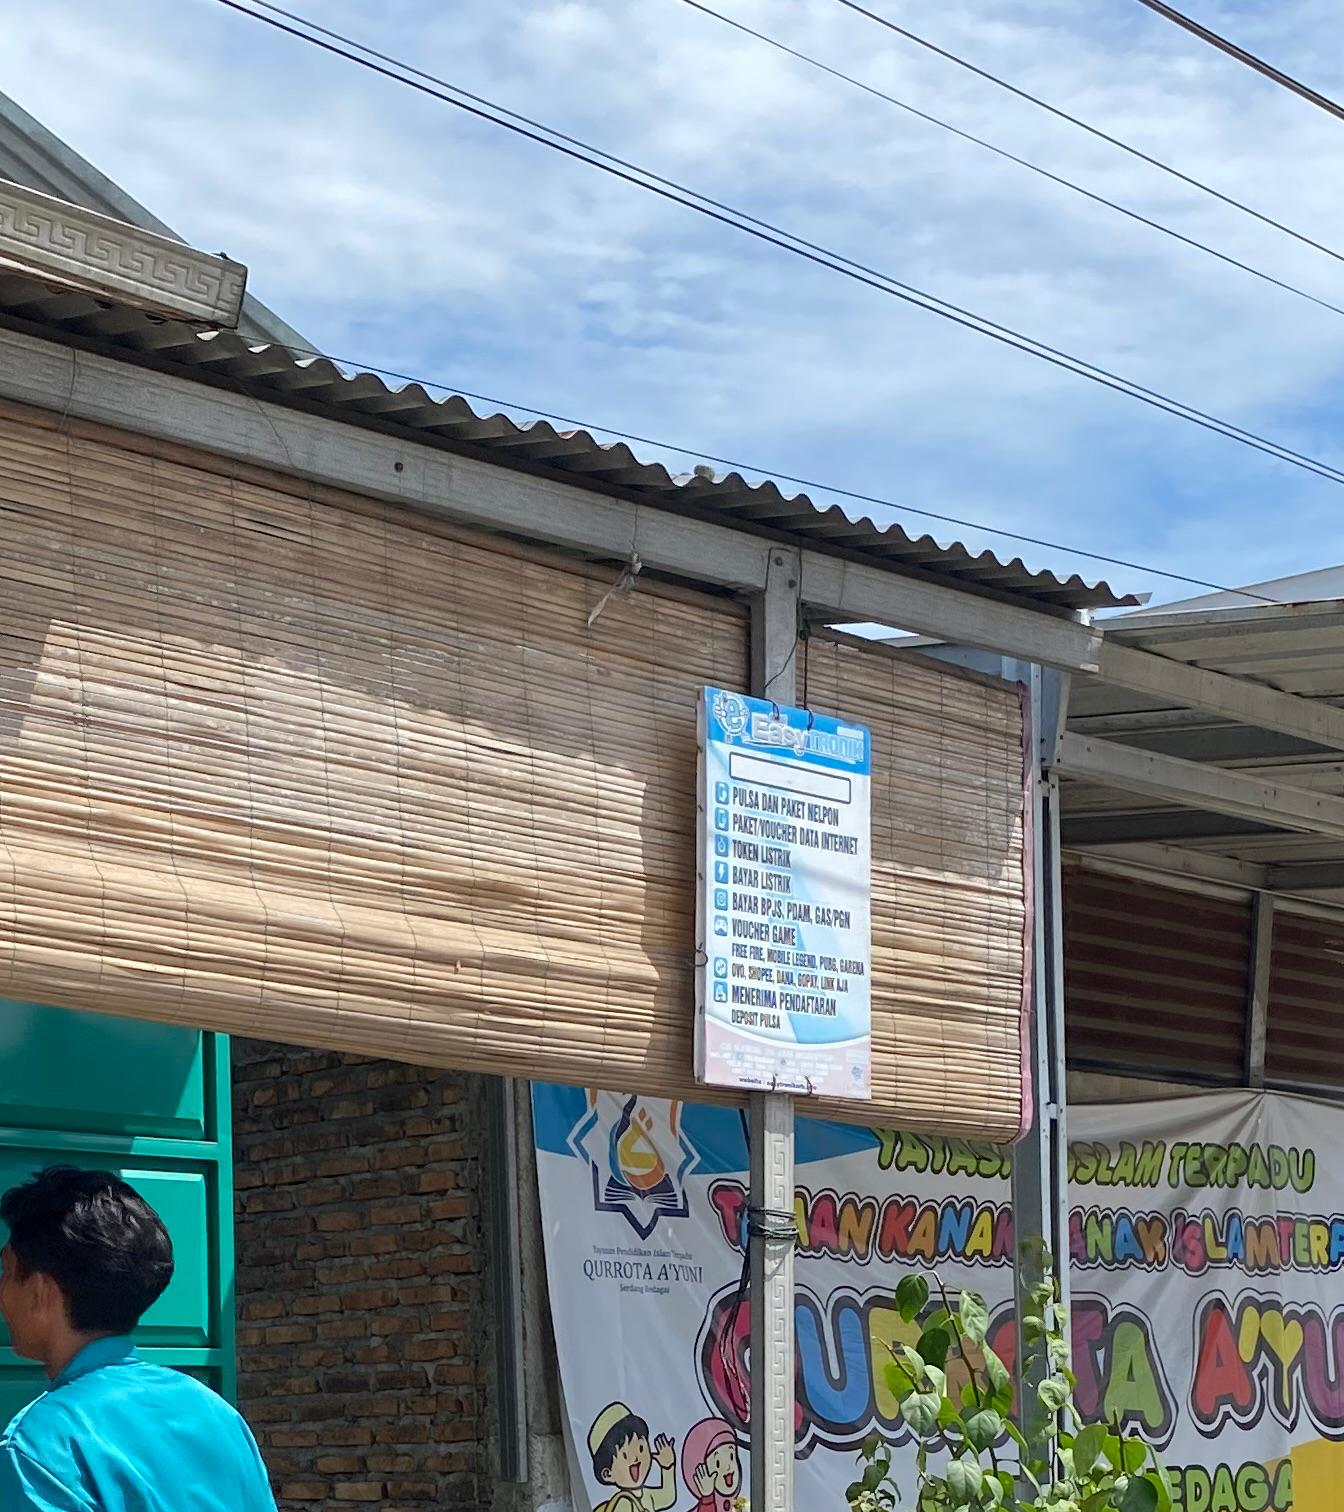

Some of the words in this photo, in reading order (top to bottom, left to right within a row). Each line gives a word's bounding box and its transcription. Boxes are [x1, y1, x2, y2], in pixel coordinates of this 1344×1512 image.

[732, 787, 759, 809] PULSA
[762, 793, 779, 814] DAN
[781, 797, 805, 820] PAKET
[807, 803, 839, 827] NELPON
[732, 813, 797, 845] PAKET/VOUCHER
[799, 827, 819, 849] DATA
[821, 831, 858, 855] INTERNET
[732, 839, 759, 863] TOKEN
[761, 845, 791, 868] LISTRIK
[732, 865, 759, 888] BAYAR
[761, 871, 791, 894] LISTRIK
[732, 892, 759, 915] BAYAR
[761, 898, 785, 921] BPJS,
[787, 901, 813, 926] PDAM,
[732, 918, 770, 942] VOUCHER
[772, 925, 796, 946] GAME
[732, 943, 748, 959] FREE
[767, 948, 791, 965] MOBILE
[836, 978, 849, 993] AJA
[732, 985, 777, 1010] MENERIMA
[779, 993, 837, 1016] PENDAFTARAN
[731, 1009, 759, 1027] DEPOSIT
[760, 1013, 781, 1030] PULSA
[1168, 1141, 1316, 1194] TERPADU
[1068, 1208, 1168, 1267] ANAK
[583, 1259, 653, 1280] QURROTA
[657, 1263, 703, 1284] A'YUNI
